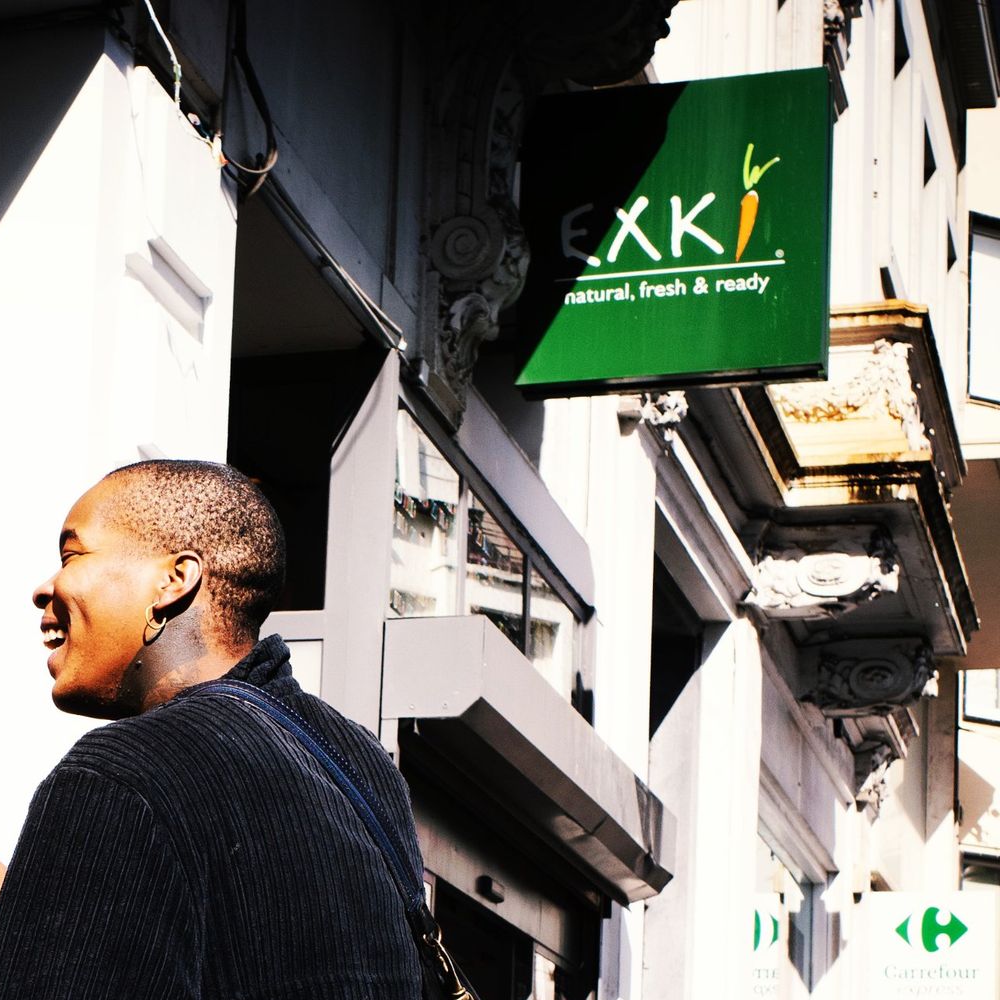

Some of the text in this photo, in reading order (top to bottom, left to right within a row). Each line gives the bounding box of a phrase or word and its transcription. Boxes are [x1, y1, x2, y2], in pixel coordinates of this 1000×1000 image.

[564, 272, 771, 305] natural, fresh & ready
[884, 963, 979, 979] Carrefour
